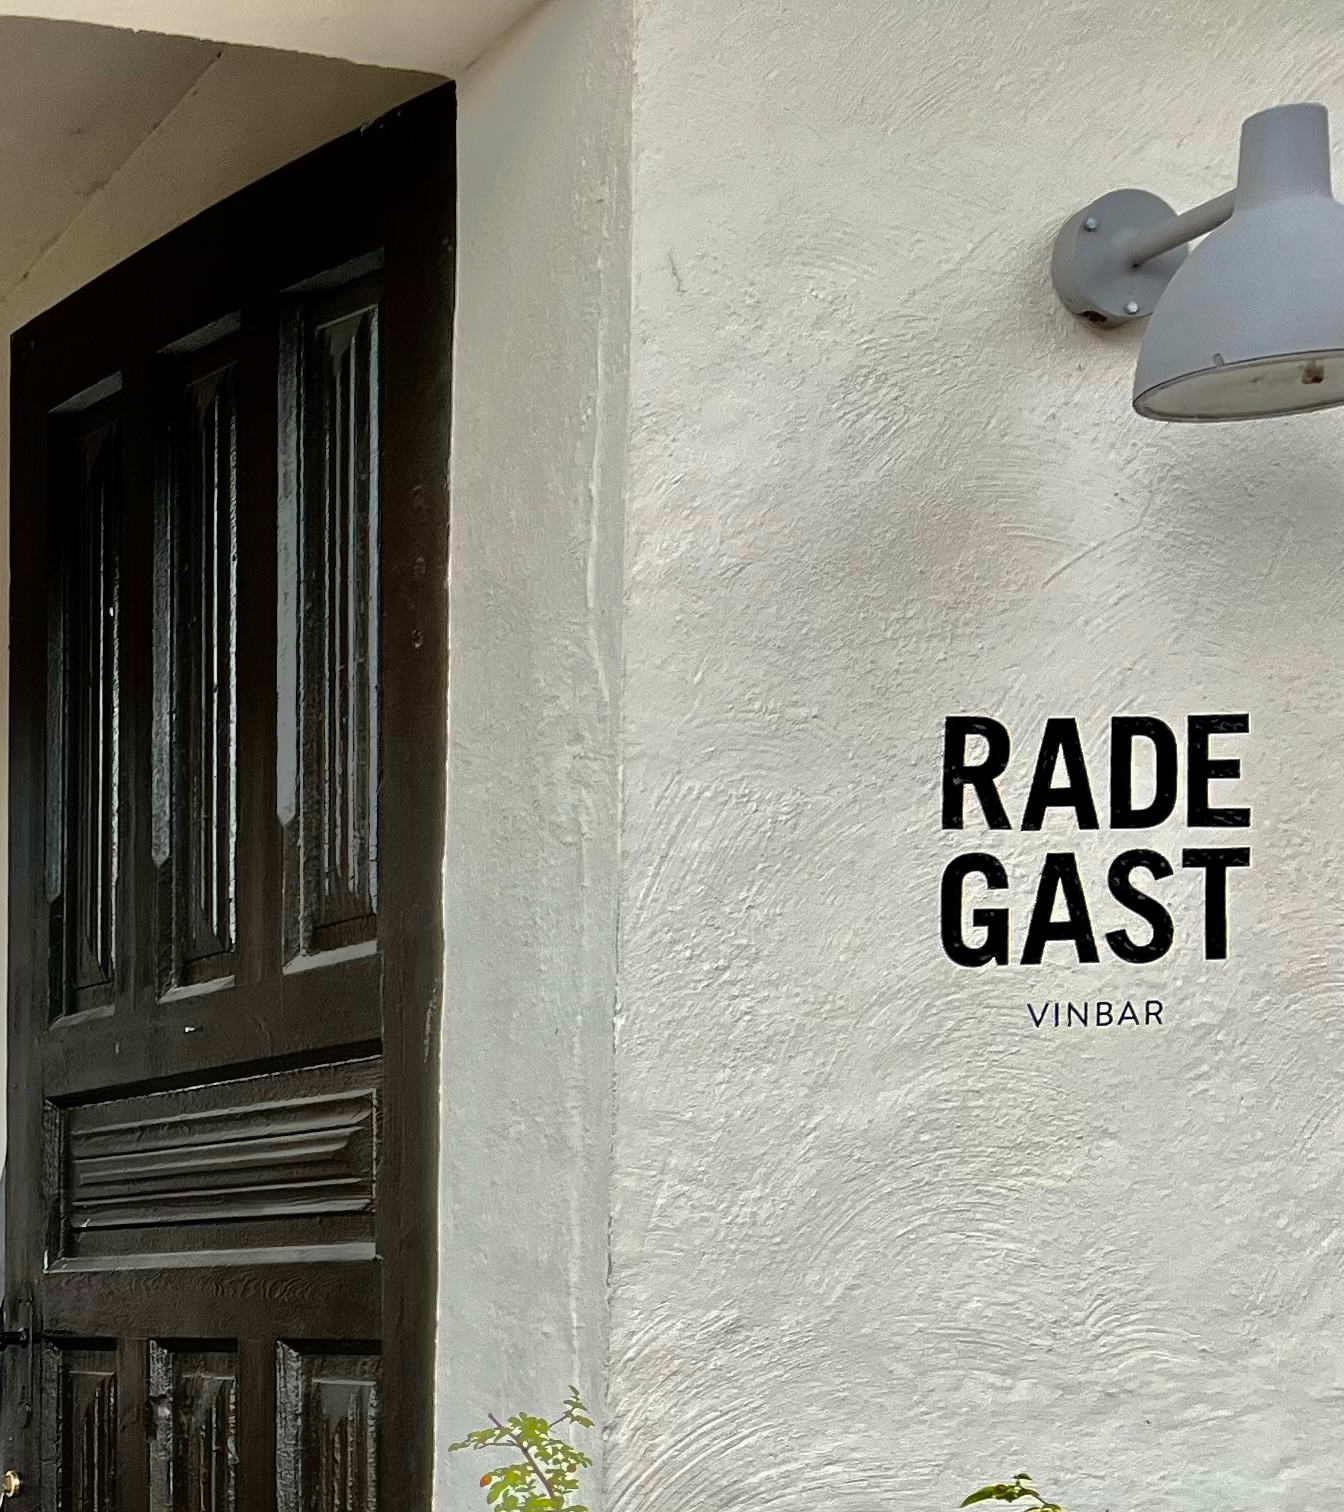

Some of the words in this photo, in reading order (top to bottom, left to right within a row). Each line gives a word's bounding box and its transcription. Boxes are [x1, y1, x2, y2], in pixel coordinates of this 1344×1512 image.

[941, 713, 1251, 832] RADE
[940, 846, 1251, 968] GAST
[1027, 1000, 1164, 1028] VINBAR
